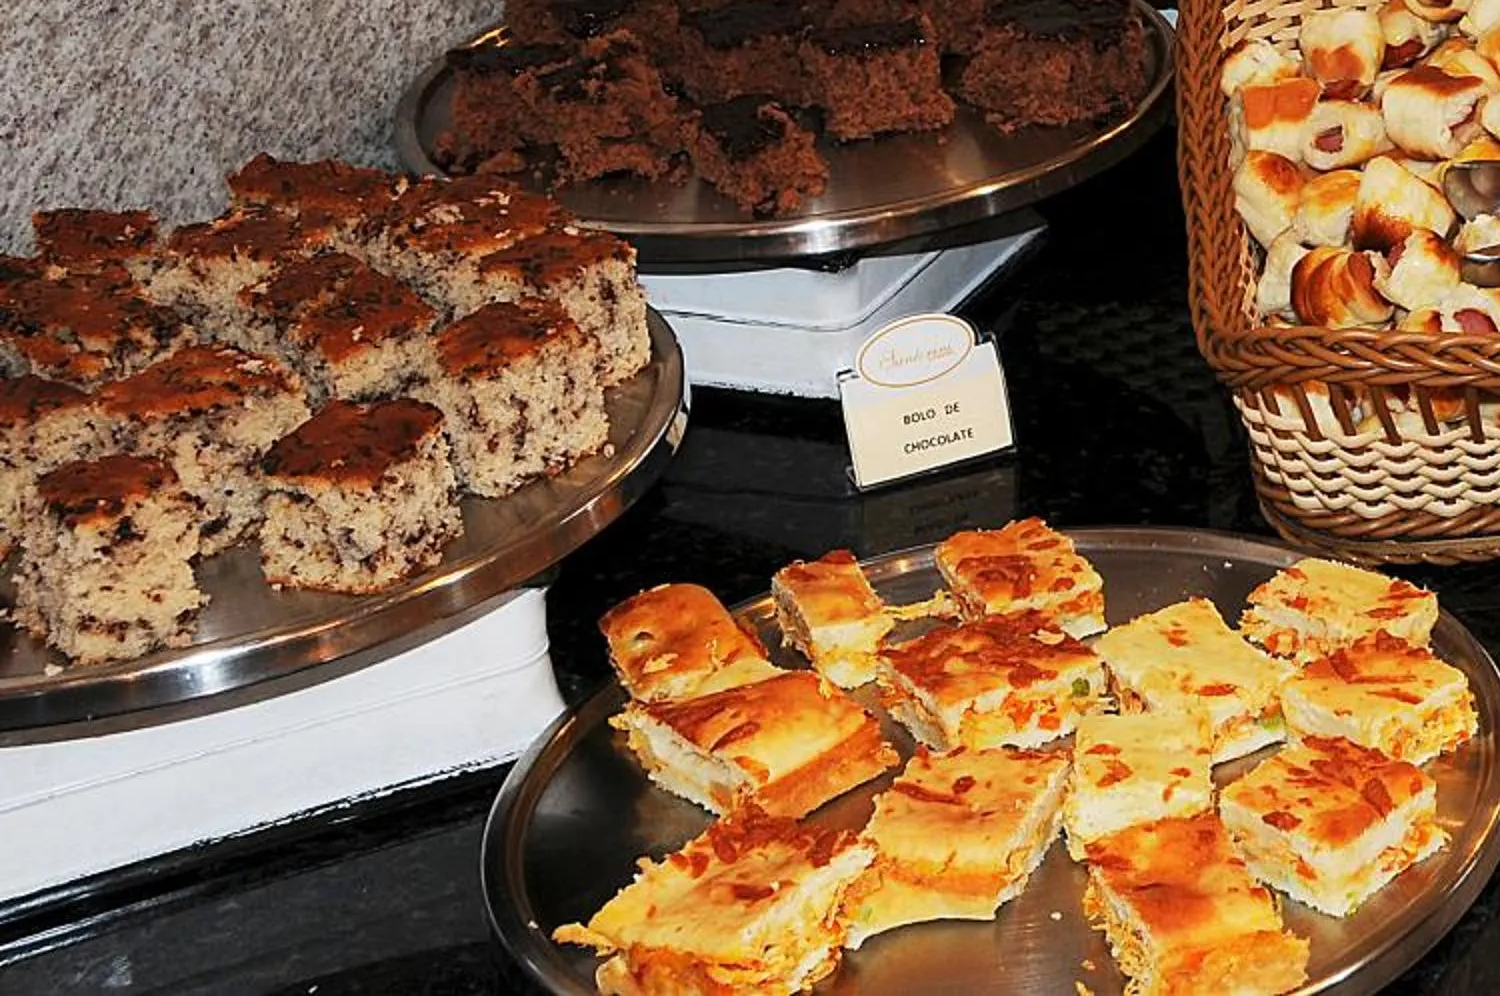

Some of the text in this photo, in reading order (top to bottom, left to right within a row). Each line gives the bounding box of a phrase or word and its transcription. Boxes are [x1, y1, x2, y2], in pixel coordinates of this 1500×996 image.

[903, 401, 960, 425] BOLO DE
[903, 427, 974, 454] CHOCOLATE
